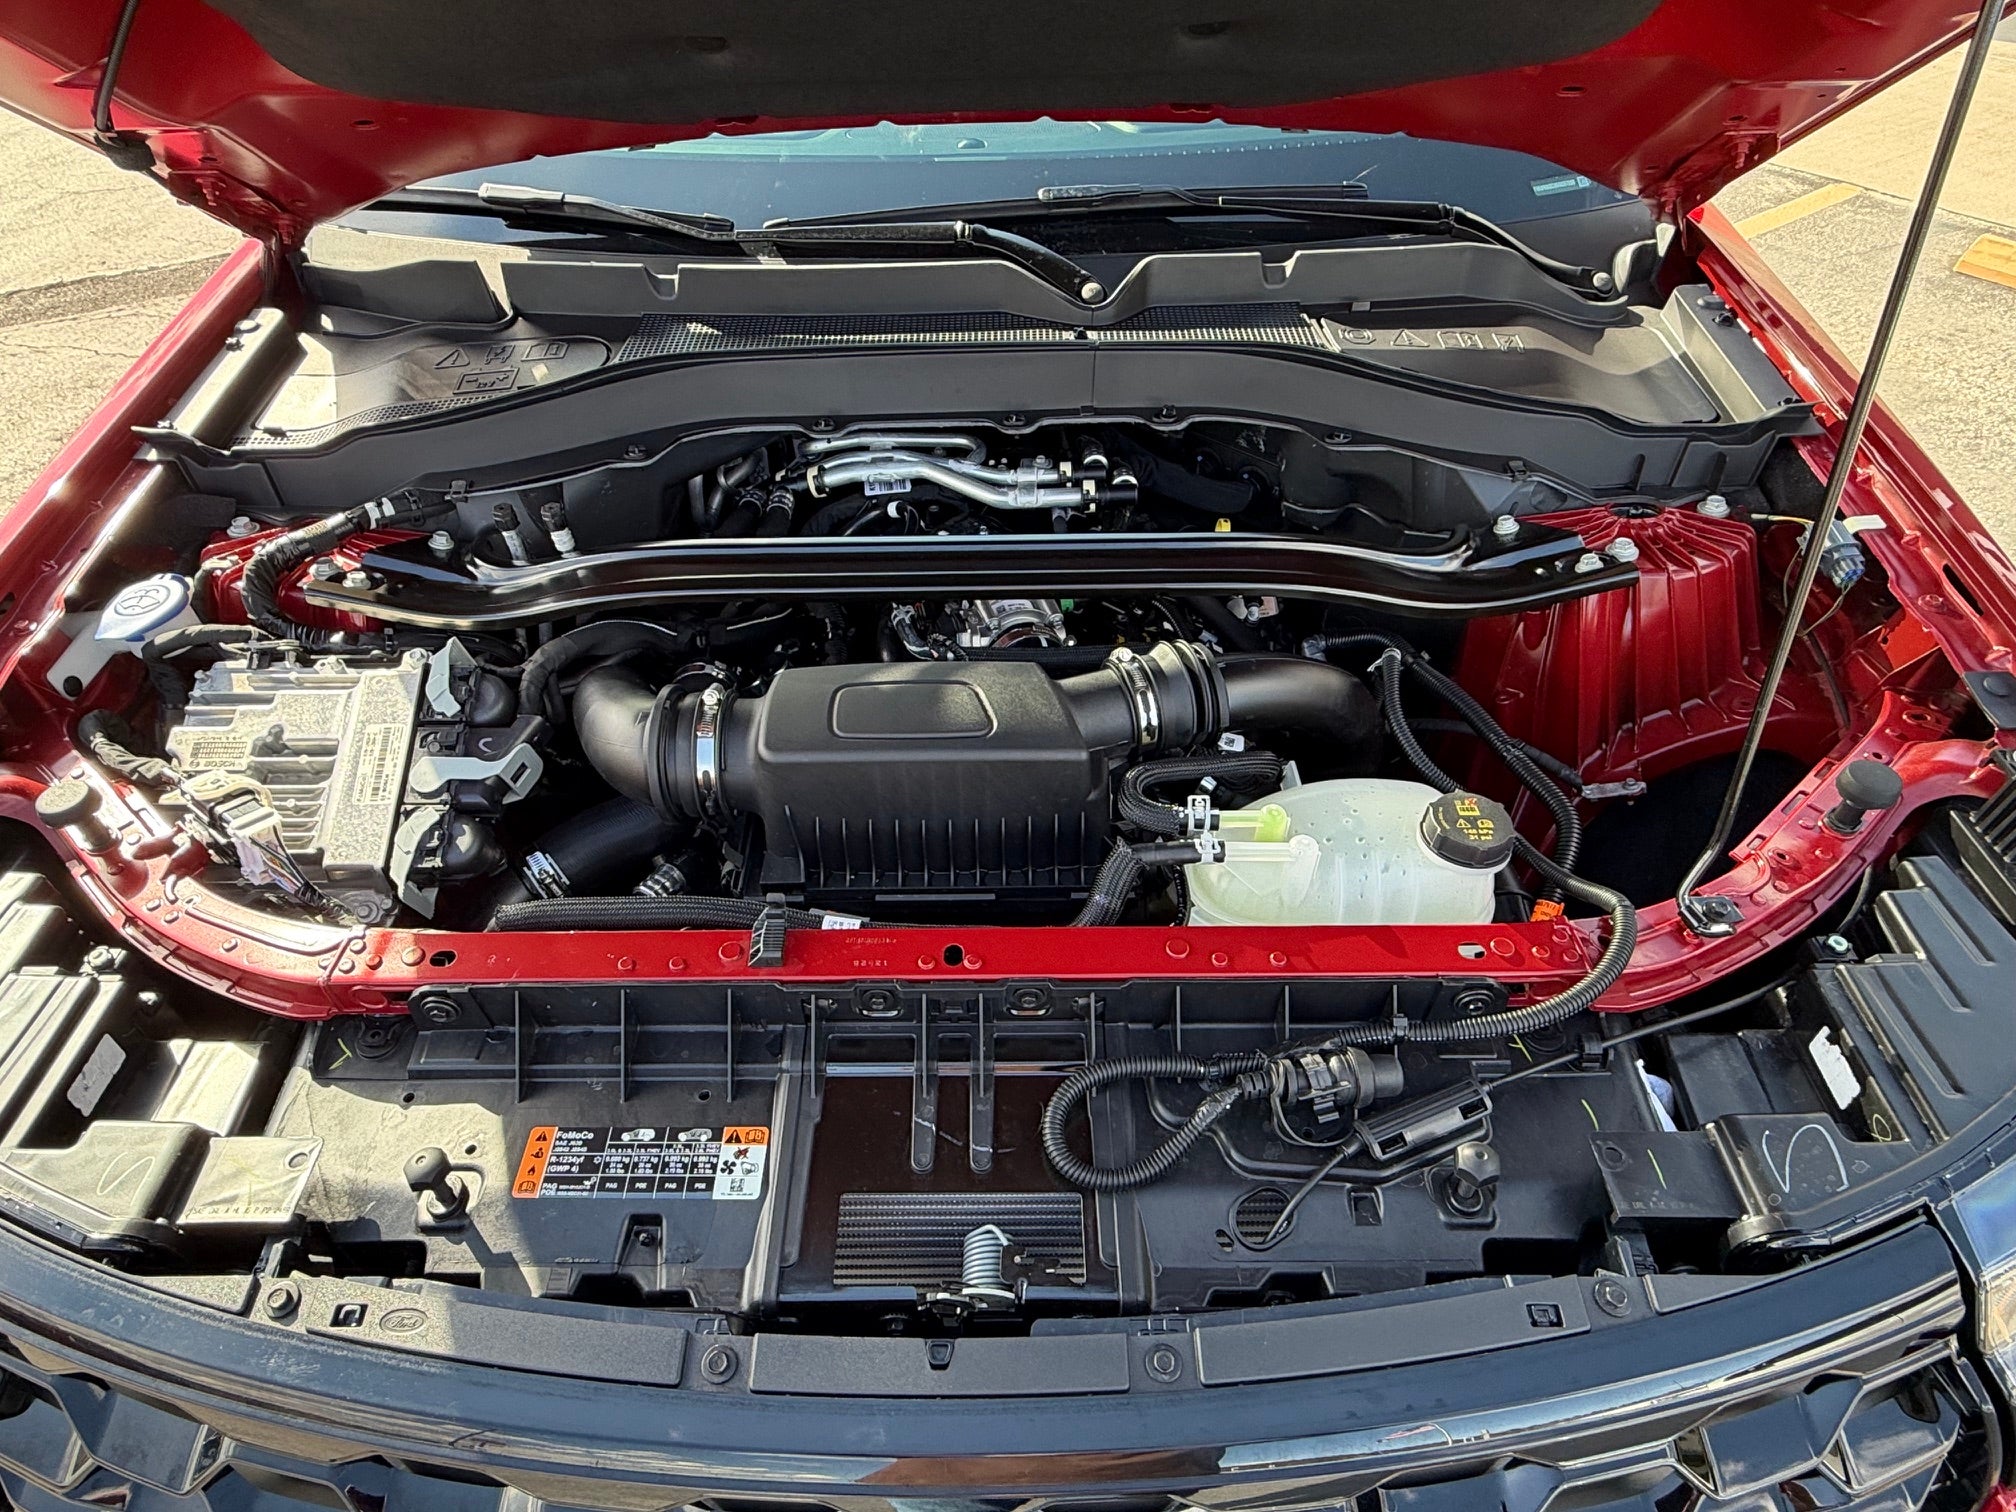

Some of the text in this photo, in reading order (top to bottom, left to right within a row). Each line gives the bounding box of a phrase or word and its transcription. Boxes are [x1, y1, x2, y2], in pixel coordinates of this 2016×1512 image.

[556, 1131, 594, 1140] FoMoCo
[550, 1156, 585, 1164] R-1234yf
[547, 1165, 580, 1173] (GWP 4)
